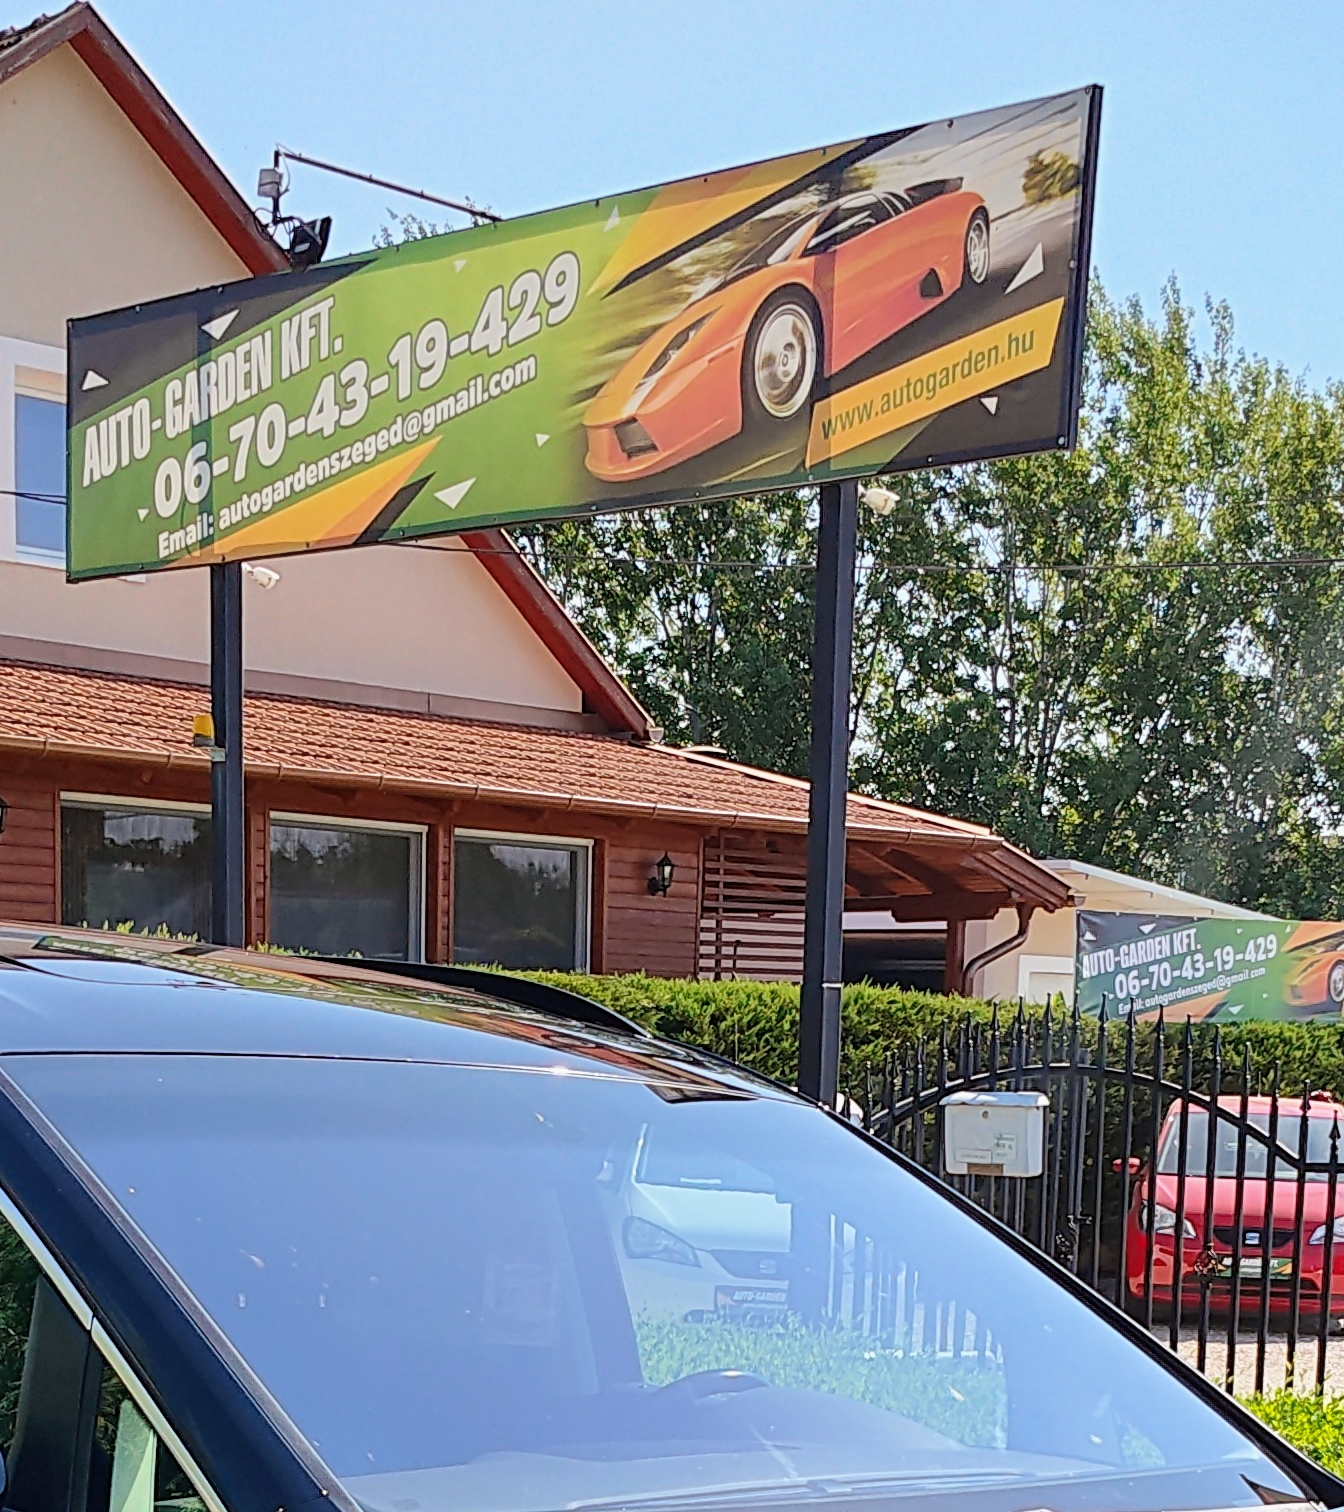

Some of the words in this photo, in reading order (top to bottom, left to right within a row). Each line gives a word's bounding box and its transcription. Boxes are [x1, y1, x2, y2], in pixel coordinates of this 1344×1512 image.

[82, 328, 273, 487] AUTO-GARDEN
[280, 296, 344, 381] KFT.
[154, 250, 581, 519] 06-70-43-19-429
[157, 513, 215, 559] Email:
[218, 354, 537, 533] autogardenszeged@gmail.com
[820, 329, 1035, 441] www.autogarden.hu
[1082, 934, 1172, 979] AUTO-GARDEN
[1173, 927, 1202, 955] KFT.
[1114, 933, 1278, 1000] 06-70-43-19-429
